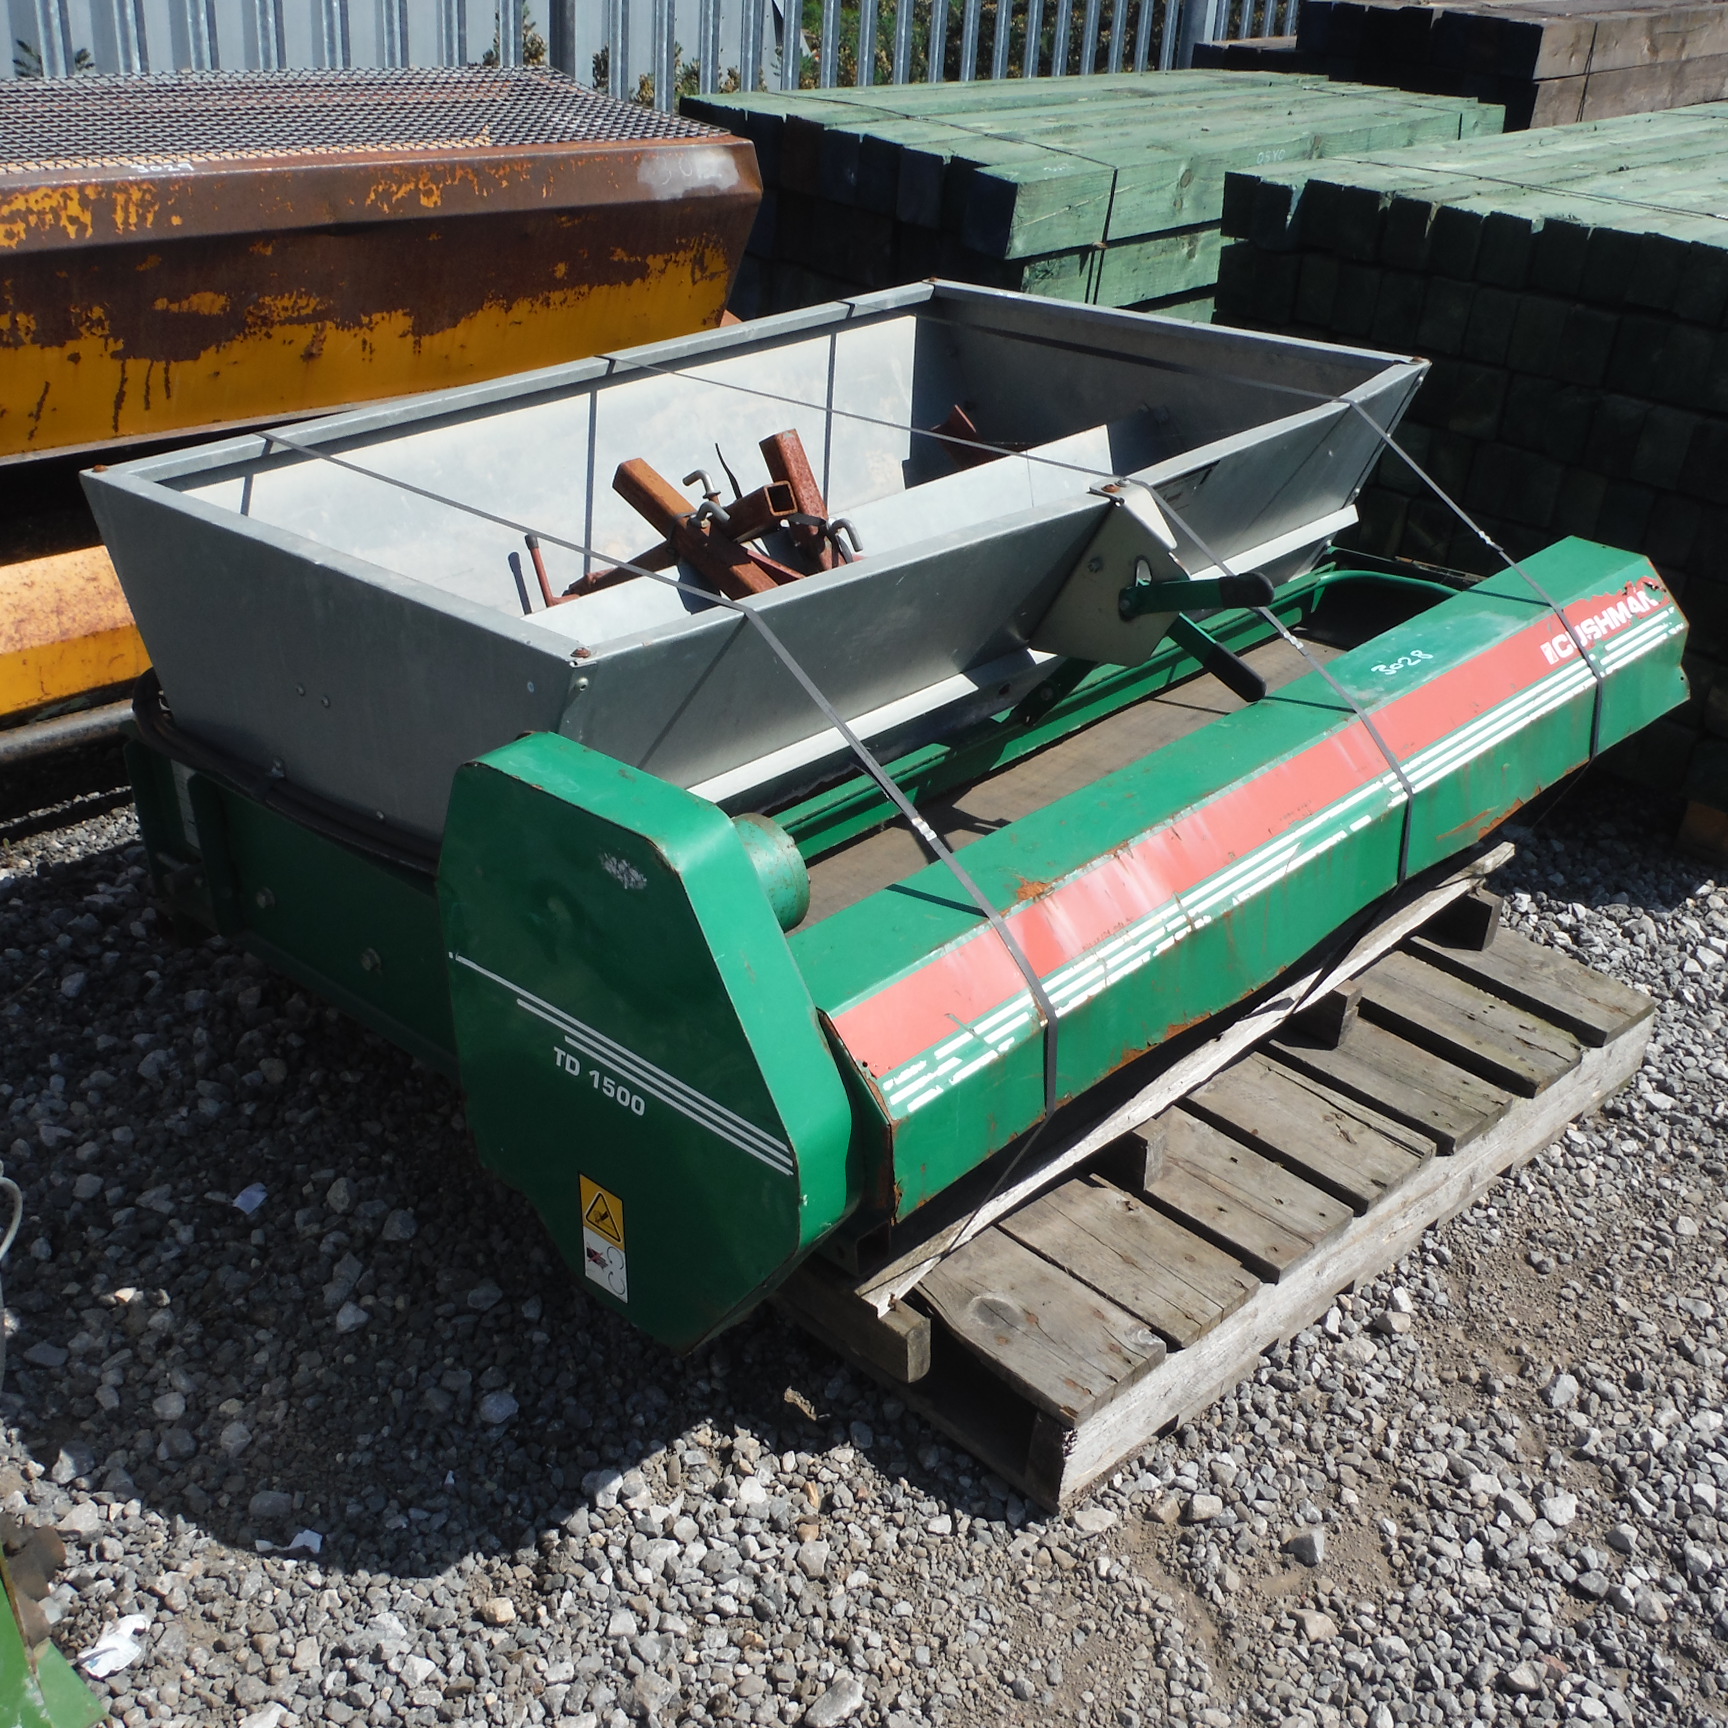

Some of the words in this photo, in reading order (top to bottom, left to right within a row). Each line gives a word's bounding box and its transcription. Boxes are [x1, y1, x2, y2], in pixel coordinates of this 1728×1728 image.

[1370, 649, 1434, 675] 3028
[553, 1045, 581, 1076] TD
[588, 1069, 646, 1117] 1500
